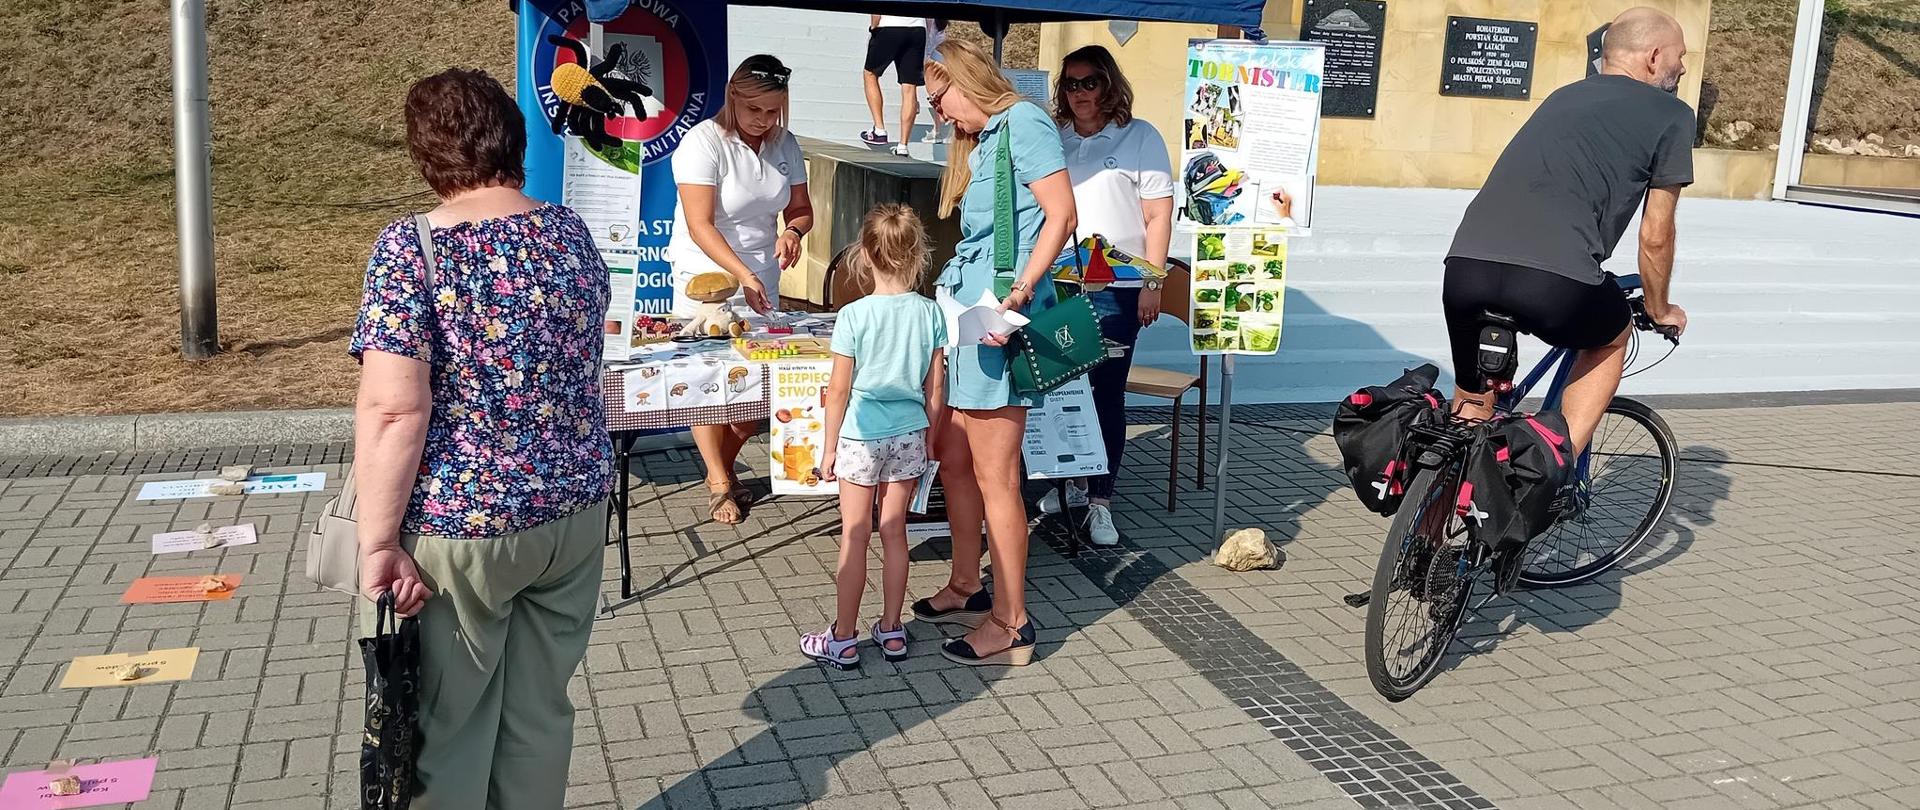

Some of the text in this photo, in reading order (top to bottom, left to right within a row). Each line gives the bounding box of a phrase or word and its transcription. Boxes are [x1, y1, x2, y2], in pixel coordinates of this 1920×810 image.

[1484, 43, 1506, 51] LATACH
[1188, 58, 1320, 94] TORNISTER
[641, 91, 705, 161] ANITARNA
[778, 372, 831, 384] BEZPIEC
[778, 386, 817, 397] STWO
